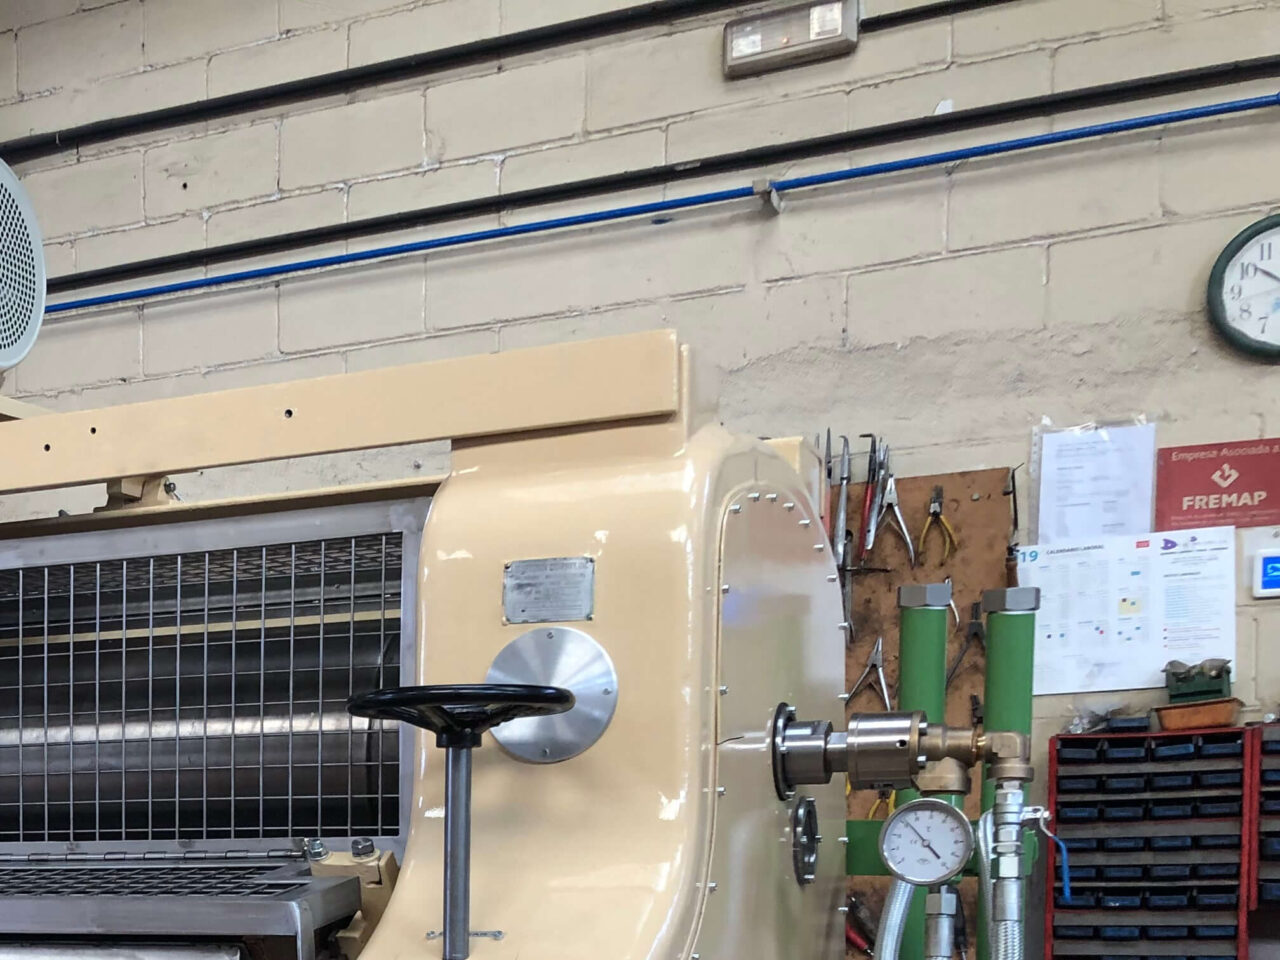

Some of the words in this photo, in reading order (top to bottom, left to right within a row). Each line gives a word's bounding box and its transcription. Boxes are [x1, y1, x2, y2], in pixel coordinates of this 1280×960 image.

[1260, 242, 1272, 261] 11
[1240, 262, 1257, 281] 10
[1230, 284, 1242, 301] 9
[1239, 301, 1252, 320] 8
[1258, 316, 1269, 334] 7
[1171, 450, 1218, 463] Empresa
[1220, 444, 1270, 457] Asociada
[1182, 491, 1267, 511] FREMAP
[1016, 550, 1039, 563] 19
